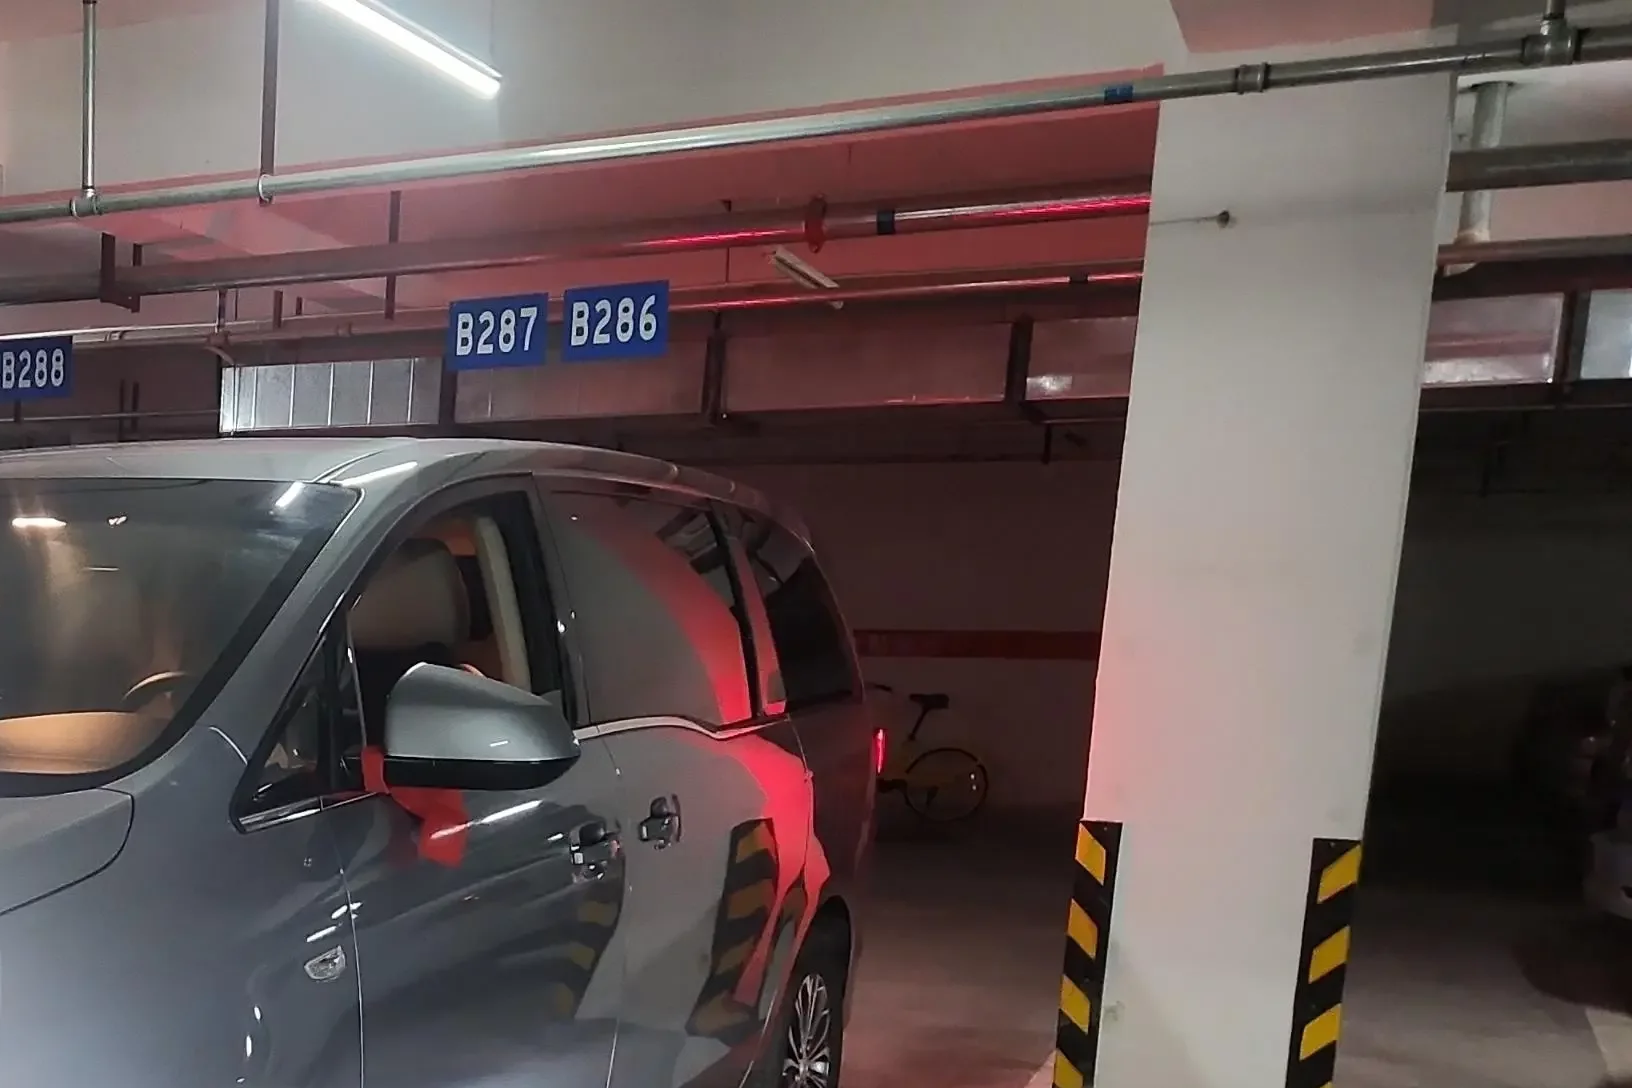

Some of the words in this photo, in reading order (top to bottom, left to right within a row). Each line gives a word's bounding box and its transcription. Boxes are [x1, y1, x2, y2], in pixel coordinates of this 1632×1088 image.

[456, 306, 538, 356] B287
[570, 294, 657, 347] B286
[2, 348, 65, 389] B288
